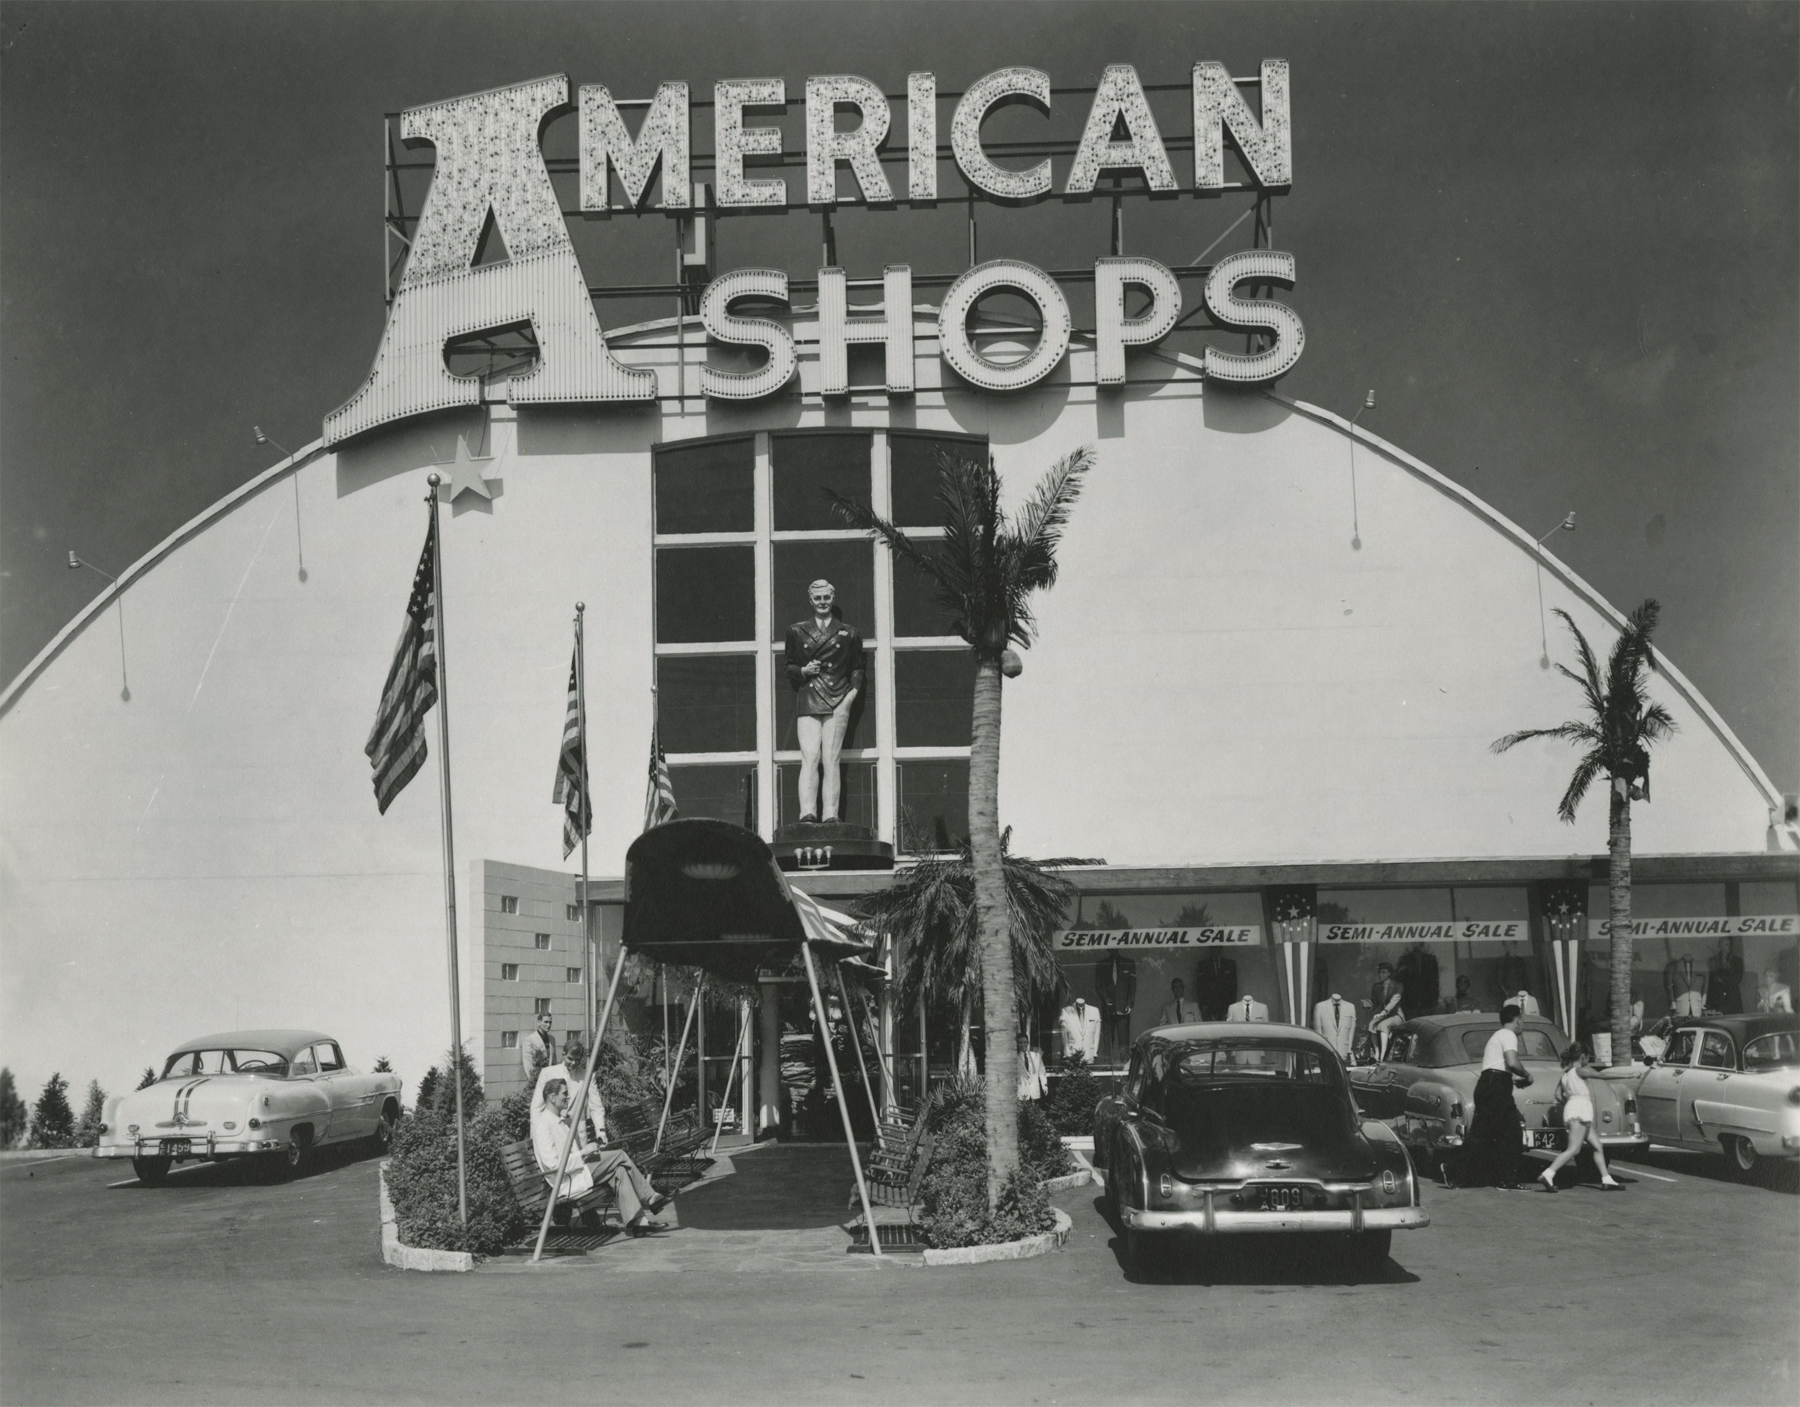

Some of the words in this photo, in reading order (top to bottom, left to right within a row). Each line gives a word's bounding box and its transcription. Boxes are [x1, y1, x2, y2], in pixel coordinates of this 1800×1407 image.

[323, 57, 1293, 448] AMERICAN
[700, 250, 1306, 400] SHOPS
[1326, 924, 1454, 941] SEMI-ANNUAL
[1462, 923, 1519, 938] SALE
[1598, 920, 1732, 936] SMI-ANNUAL
[1738, 918, 1794, 933] SALE
[1061, 930, 1191, 947] SEMI-ANNUAL
[1196, 928, 1251, 944] SALE
[1271, 1188, 1300, 1206] 809
